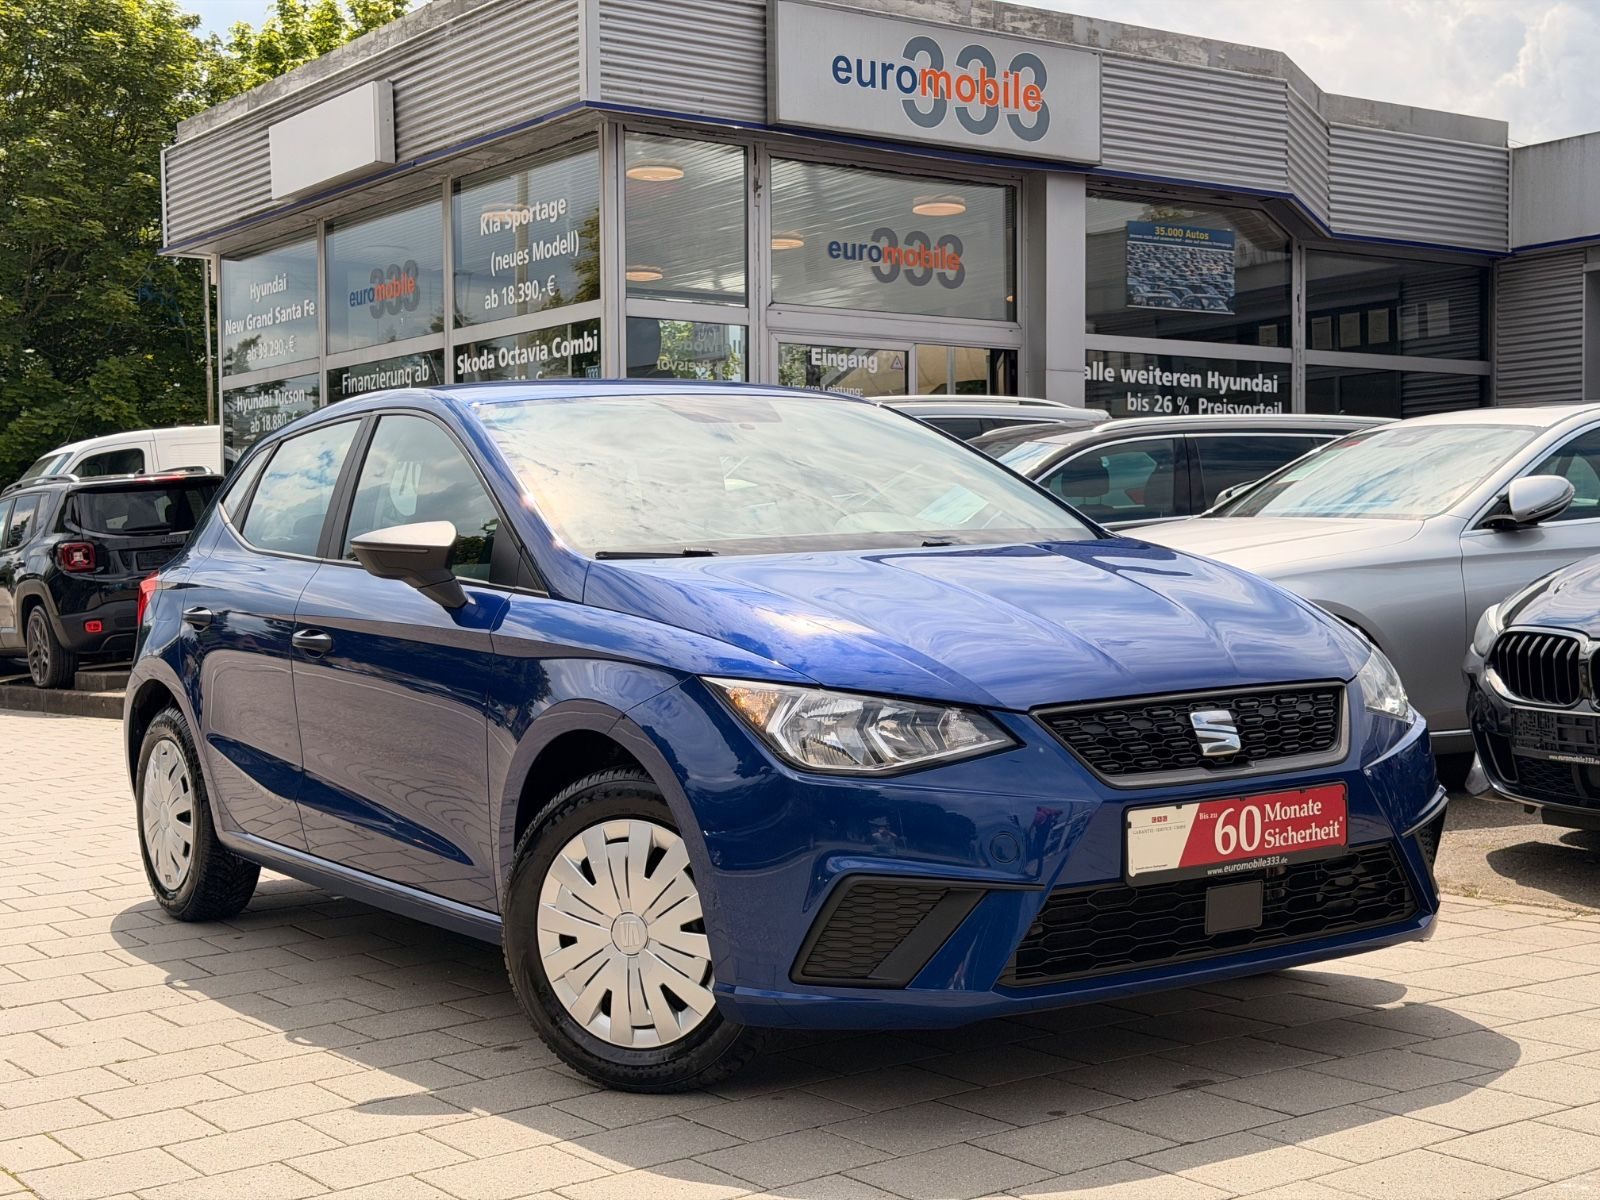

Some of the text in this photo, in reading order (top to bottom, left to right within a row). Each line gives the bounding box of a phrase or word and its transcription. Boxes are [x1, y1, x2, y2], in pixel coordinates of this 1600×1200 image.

[832, 35, 1050, 142] euromobile 333
[480, 198, 567, 236] Kia Sportage
[1154, 226, 1209, 240] 35.000 Autos
[490, 230, 580, 277] (neues Modell)
[828, 227, 966, 289] euromobile 333
[249, 273, 287, 302] Hyundai
[349, 259, 420, 319] euromobile 333
[485, 288, 499, 309] ab
[225, 299, 315, 336] New Grand Santa Fe
[246, 343, 257, 361] ab
[457, 329, 598, 375] Skoda Octavia Combi
[811, 347, 878, 374] Eingang
[342, 358, 429, 394] Finanzierung ab
[1084, 361, 1278, 395] alle weiteren Hyundai
[236, 389, 305, 415] Hyundai Tucson
[1127, 391, 1283, 414] bis 26 % Preisvorteil
[250, 415, 260, 433] ab
[1264, 798, 1322, 822] Monate
[1199, 812, 1209, 820] Bis
[1214, 805, 1262, 855] 60
[1207, 855, 1288, 876] www.euromobile333.de
